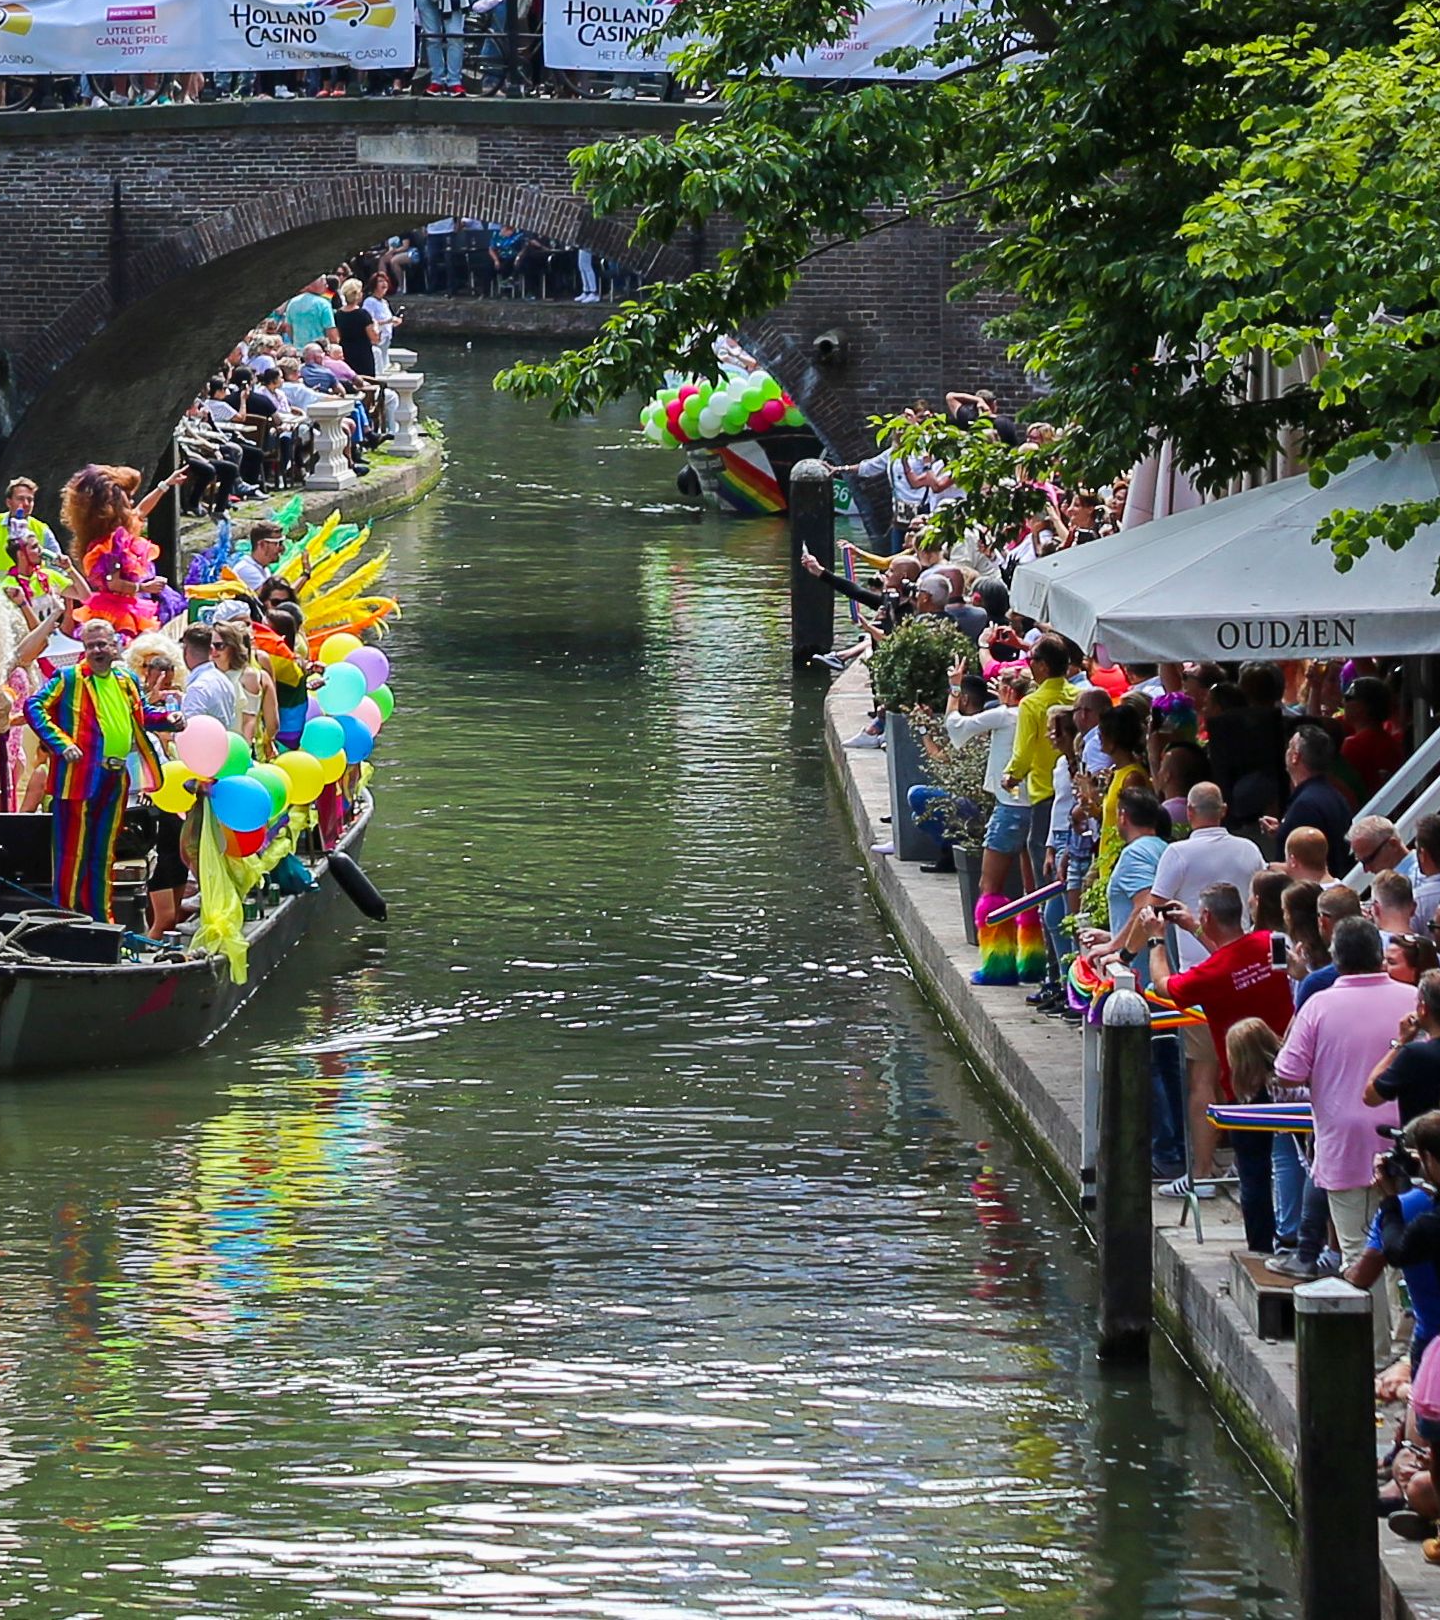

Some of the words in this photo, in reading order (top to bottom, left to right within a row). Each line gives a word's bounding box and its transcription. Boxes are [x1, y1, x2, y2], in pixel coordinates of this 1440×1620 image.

[230, 4, 326, 28] HOLLAND
[563, 0, 664, 26] HOLLAND
[106, 26, 156, 36] UTRECHT
[96, 37, 133, 46] CANAL
[136, 35, 169, 45] PRIDE
[245, 26, 317, 48] CASINO
[121, 46, 145, 55] 2017
[836, 41, 869, 51] PRIDE
[355, 48, 398, 60] CASINO
[598, 50, 616, 60] HET
[820, 51, 845, 60] 2017
